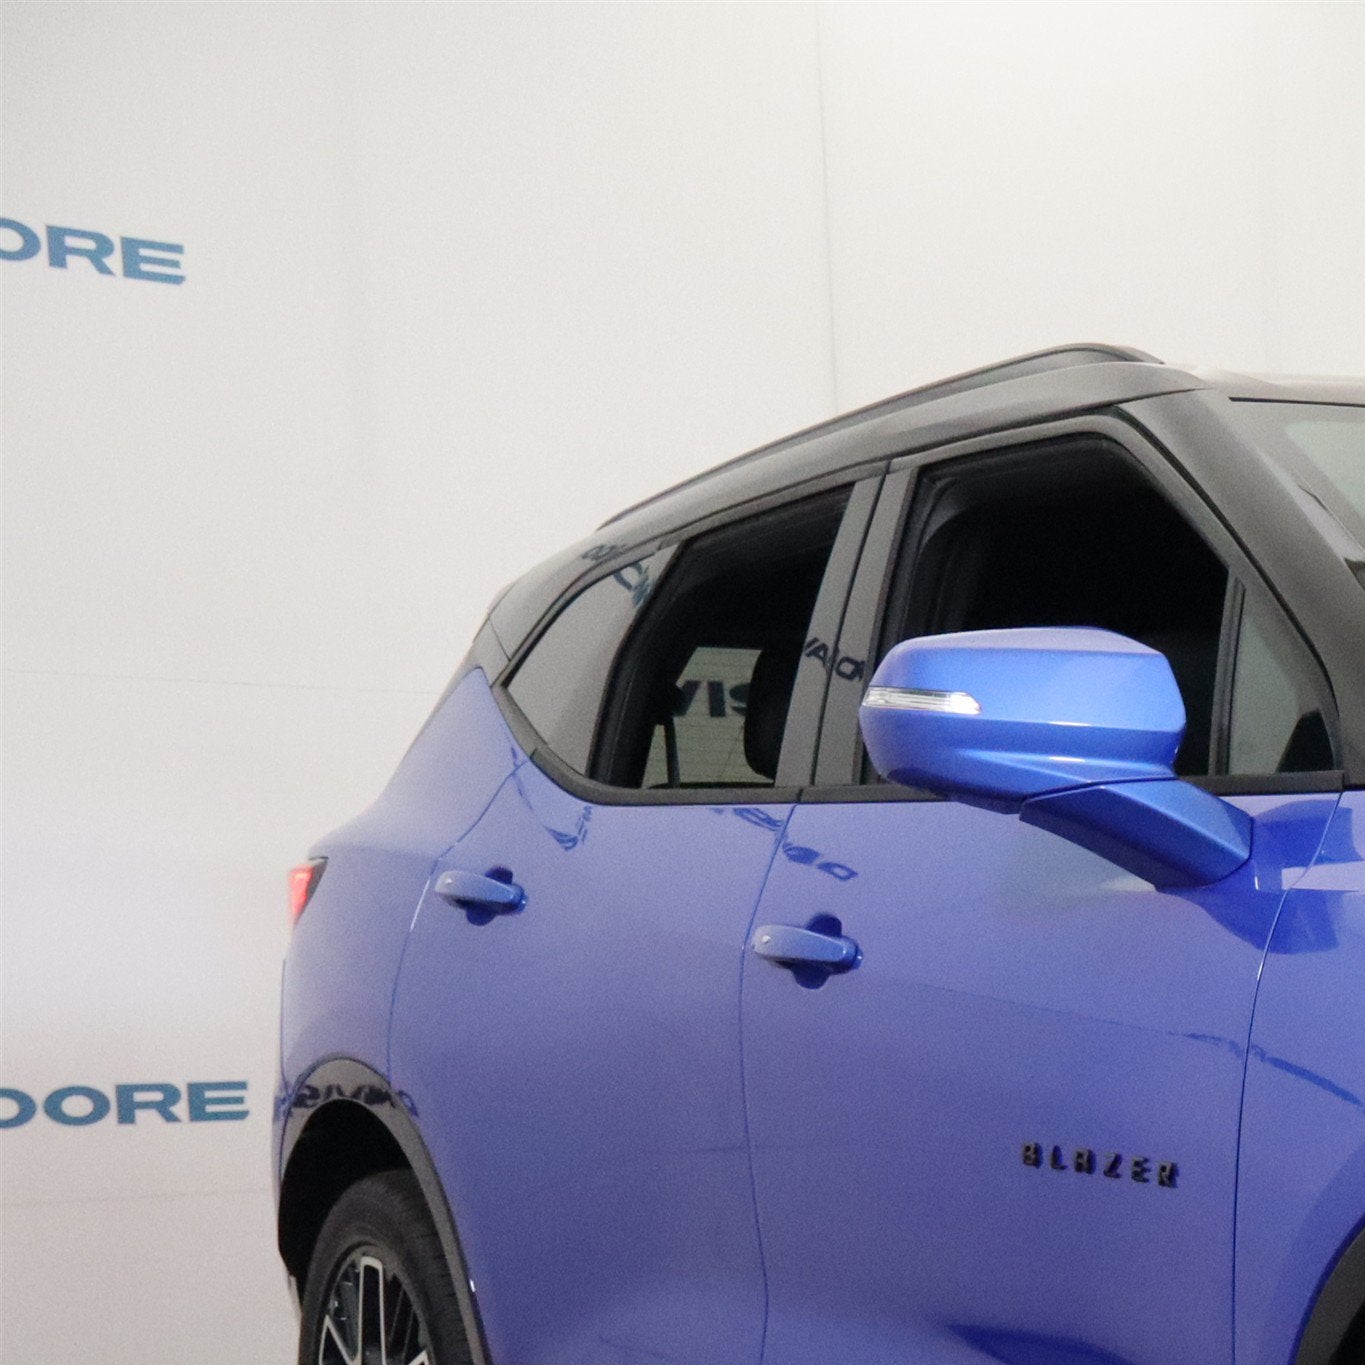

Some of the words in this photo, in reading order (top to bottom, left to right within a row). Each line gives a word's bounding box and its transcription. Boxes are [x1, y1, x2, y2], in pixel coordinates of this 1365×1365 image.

[0, 217, 185, 285] ORE
[0, 1081, 249, 1129] OORE
[1021, 1143, 1180, 1188] BLAZER
